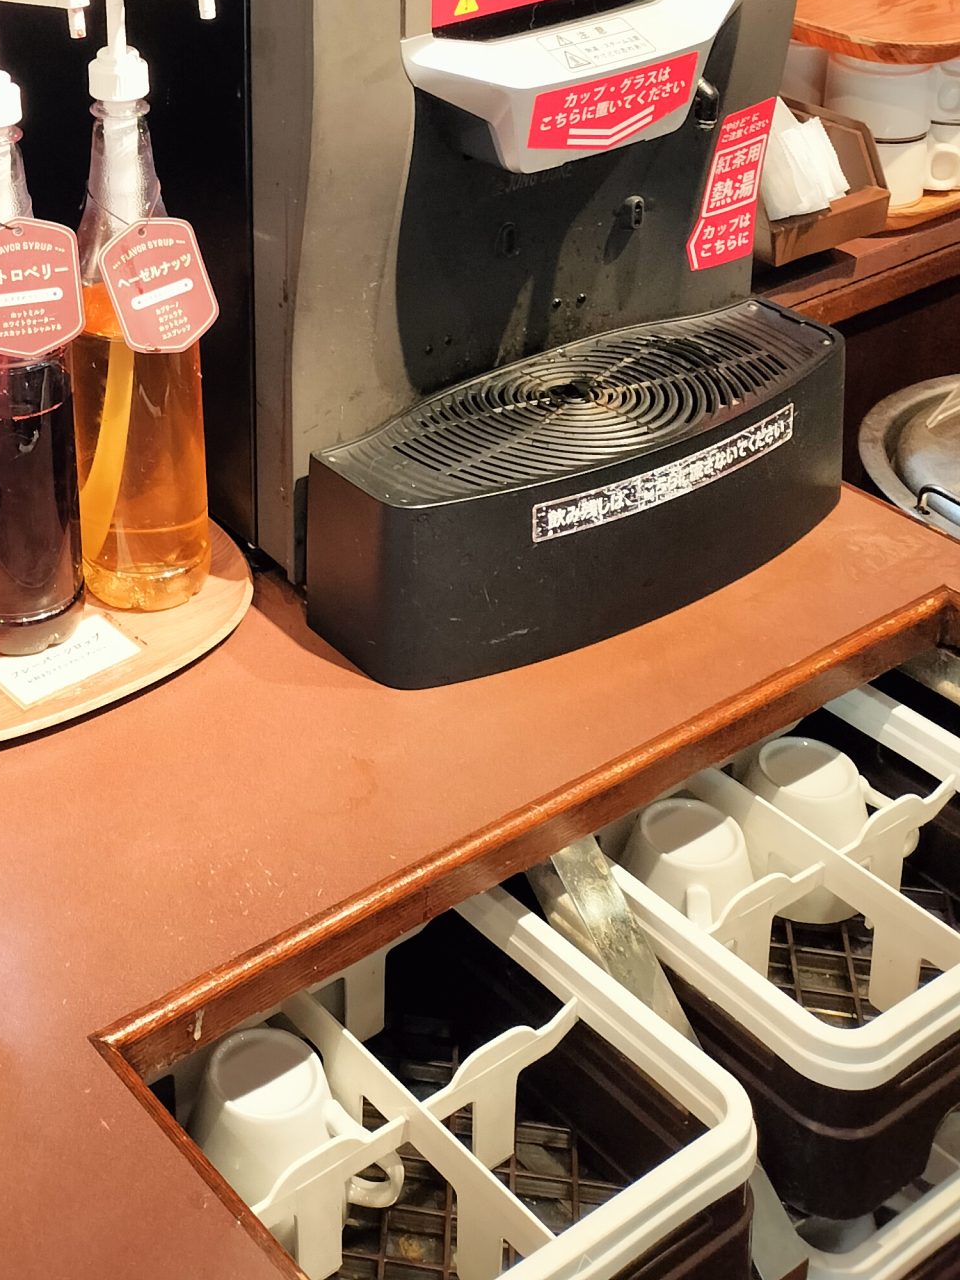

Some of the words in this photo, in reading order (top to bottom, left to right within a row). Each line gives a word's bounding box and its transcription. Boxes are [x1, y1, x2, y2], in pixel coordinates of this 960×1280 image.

[563, 66, 672, 109] カップ・グラスは
[539, 80, 686, 131] こちらに置いてください
[721, 119, 769, 143] ご注意ください
[715, 142, 762, 175] 紅茶用
[709, 169, 756, 208] 熱湯
[702, 212, 751, 240] カップは
[22, 241, 53, 252] SYRUP
[120, 243, 147, 263] FLAVOR
[147, 238, 174, 250] SYRUP
[700, 231, 750, 257] こちらに
[117, 253, 191, 288] ヘーゼルナッツ
[10, 308, 45, 319] ホットミルク
[155, 301, 179, 316] カプチーノ
[158, 309, 183, 323] カフェラテ
[2, 316, 56, 328] ホワイトウォーター
[159, 317, 189, 332] ホットミルク
[162, 324, 191, 340] エスプレッソ
